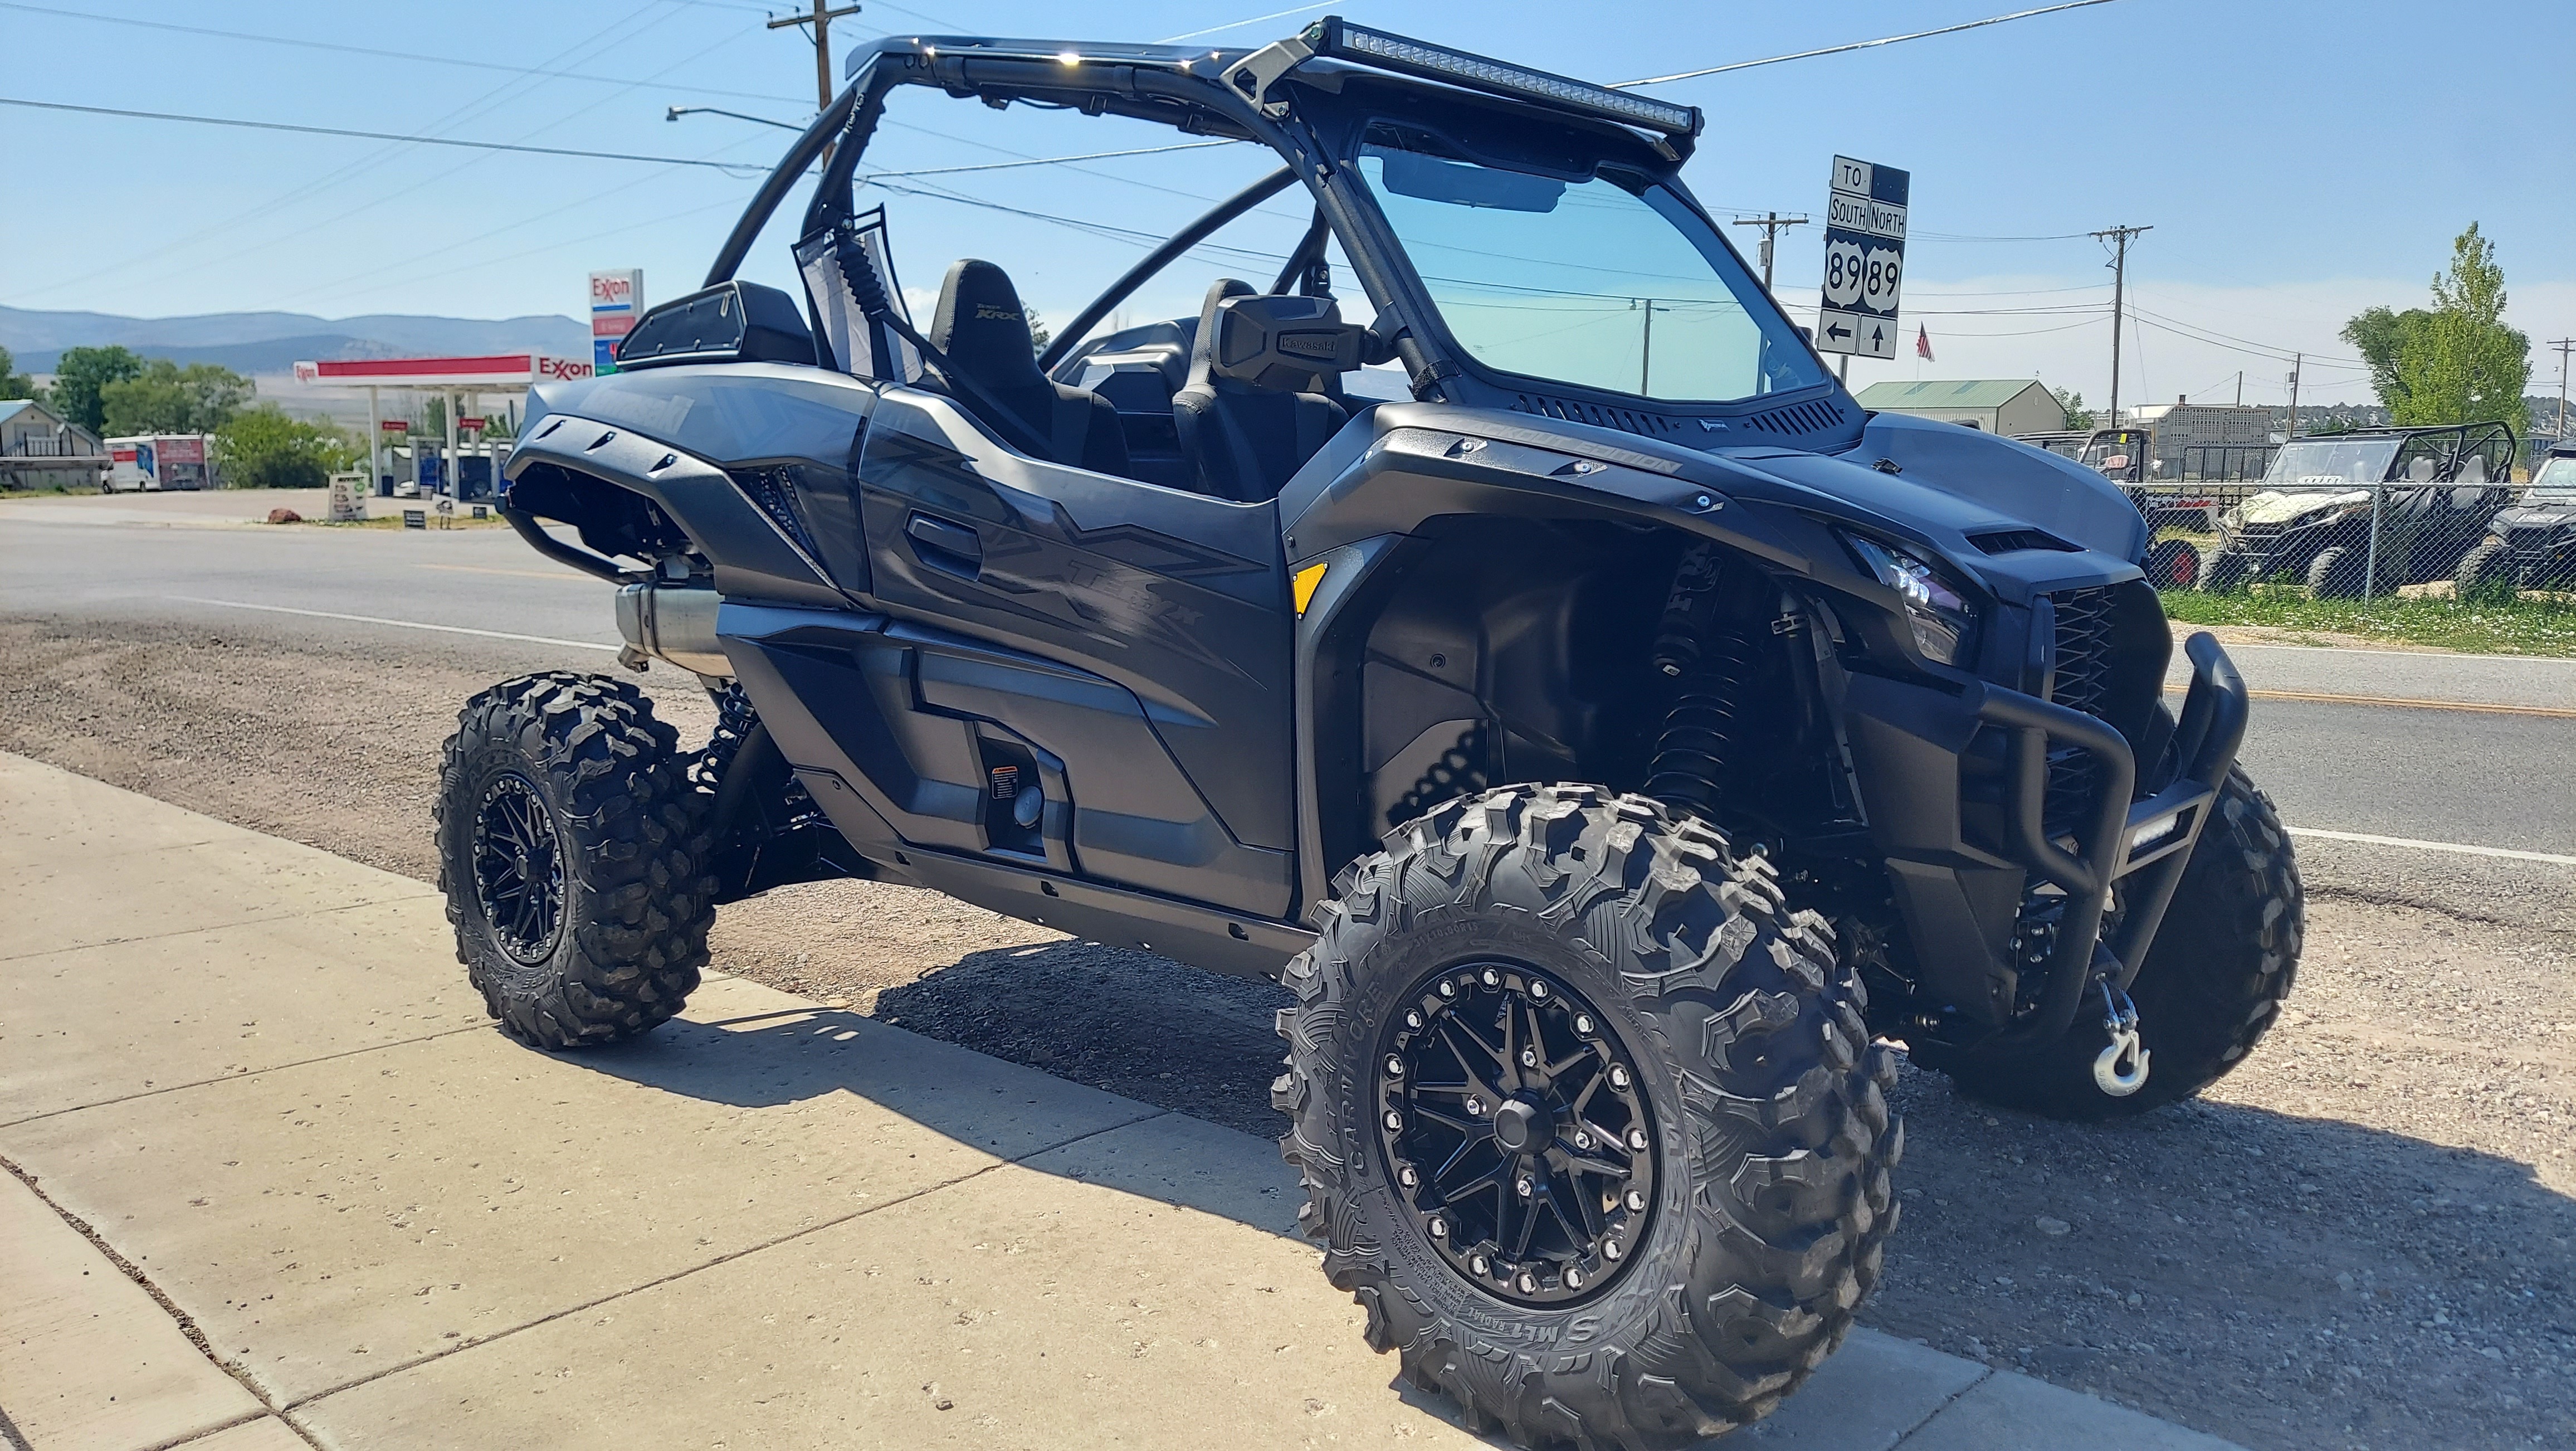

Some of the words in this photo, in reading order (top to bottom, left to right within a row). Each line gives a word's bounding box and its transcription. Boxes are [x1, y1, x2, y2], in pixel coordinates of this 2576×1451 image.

[1843, 164, 1861, 187] TO
[1831, 198, 1867, 227] SOUTH
[1871, 208, 1905, 235] NORTH
[1829, 252, 1861, 291] 89
[1868, 260, 1898, 298] 89
[593, 277, 630, 302] Exxon
[1282, 337, 1335, 352] Kawasaki
[539, 357, 592, 381] Exxon
[1438, 416, 1573, 449] BLACKOUT
[1579, 442, 1684, 474] EDITION
[1663, 542, 1712, 613] FOX
[1341, 980, 1383, 1170] CARNIVORE
